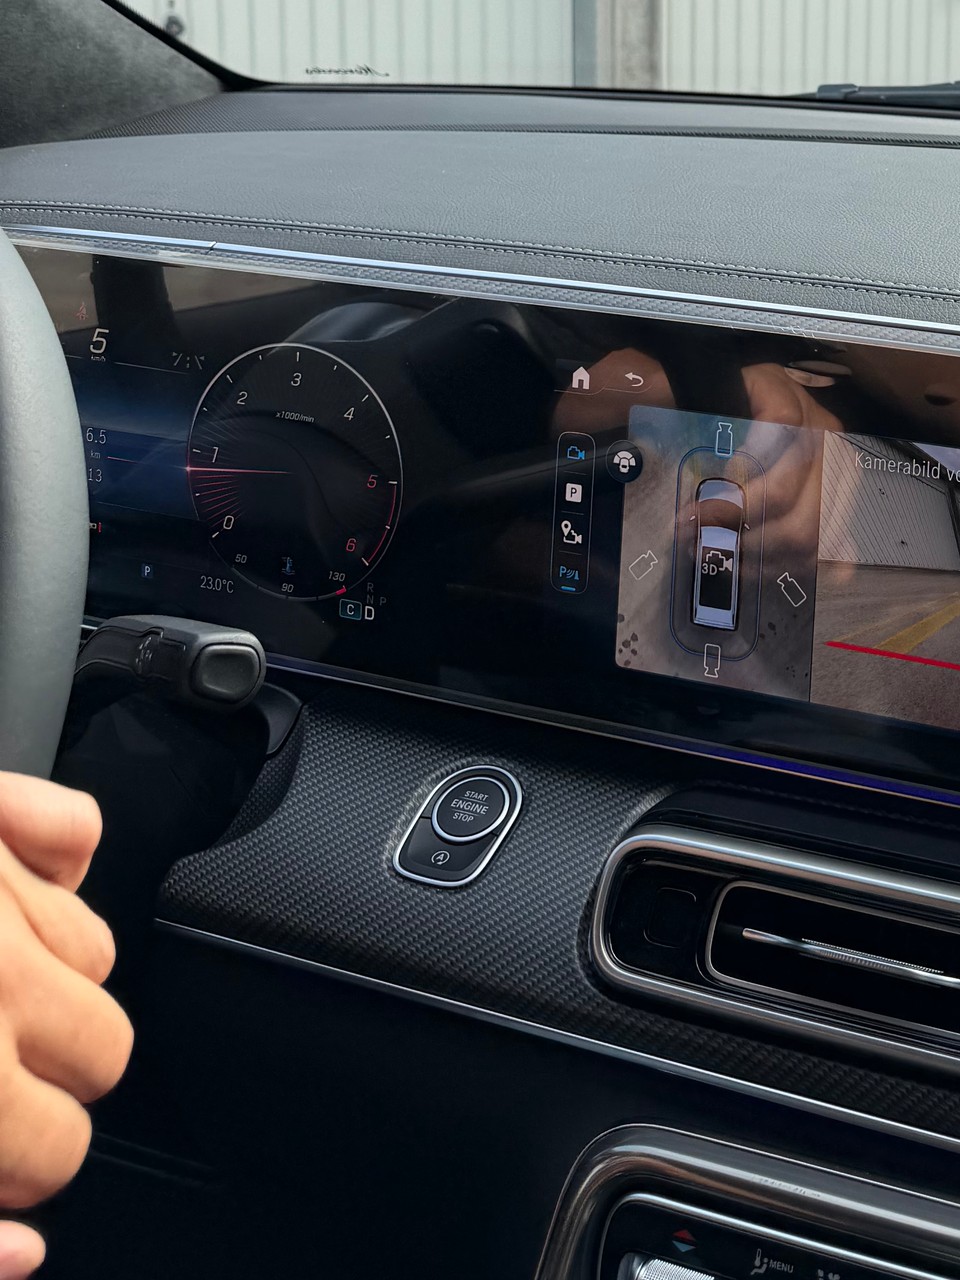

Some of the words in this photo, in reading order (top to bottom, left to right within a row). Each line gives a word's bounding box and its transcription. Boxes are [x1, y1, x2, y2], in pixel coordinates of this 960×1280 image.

[90, 328, 110, 354] 5
[291, 373, 302, 386] 3
[236, 391, 248, 405] 2
[276, 410, 315, 423] x1000/min
[344, 407, 355, 421] 4
[86, 427, 107, 444] 6.5
[212, 446, 220, 463] 1
[855, 452, 941, 479] Kamerabild
[88, 468, 102, 482] 13
[367, 474, 378, 488] 5
[569, 487, 577, 498] P
[223, 515, 235, 530] 0
[346, 538, 357, 552] 6
[235, 554, 247, 564] 50
[328, 570, 346, 582] 130
[702, 563, 717, 575] 3D
[200, 575, 234, 593] 23.0°C
[281, 583, 294, 593] 90
[367, 582, 374, 593] R
[366, 594, 374, 604] N
[379, 596, 387, 606] P
[346, 604, 355, 615] C
[365, 606, 375, 620] D
[464, 790, 489, 801] START
[450, 798, 489, 815] ENGINE
[452, 812, 474, 823] STOP
[768, 1259, 794, 1273] MENU
